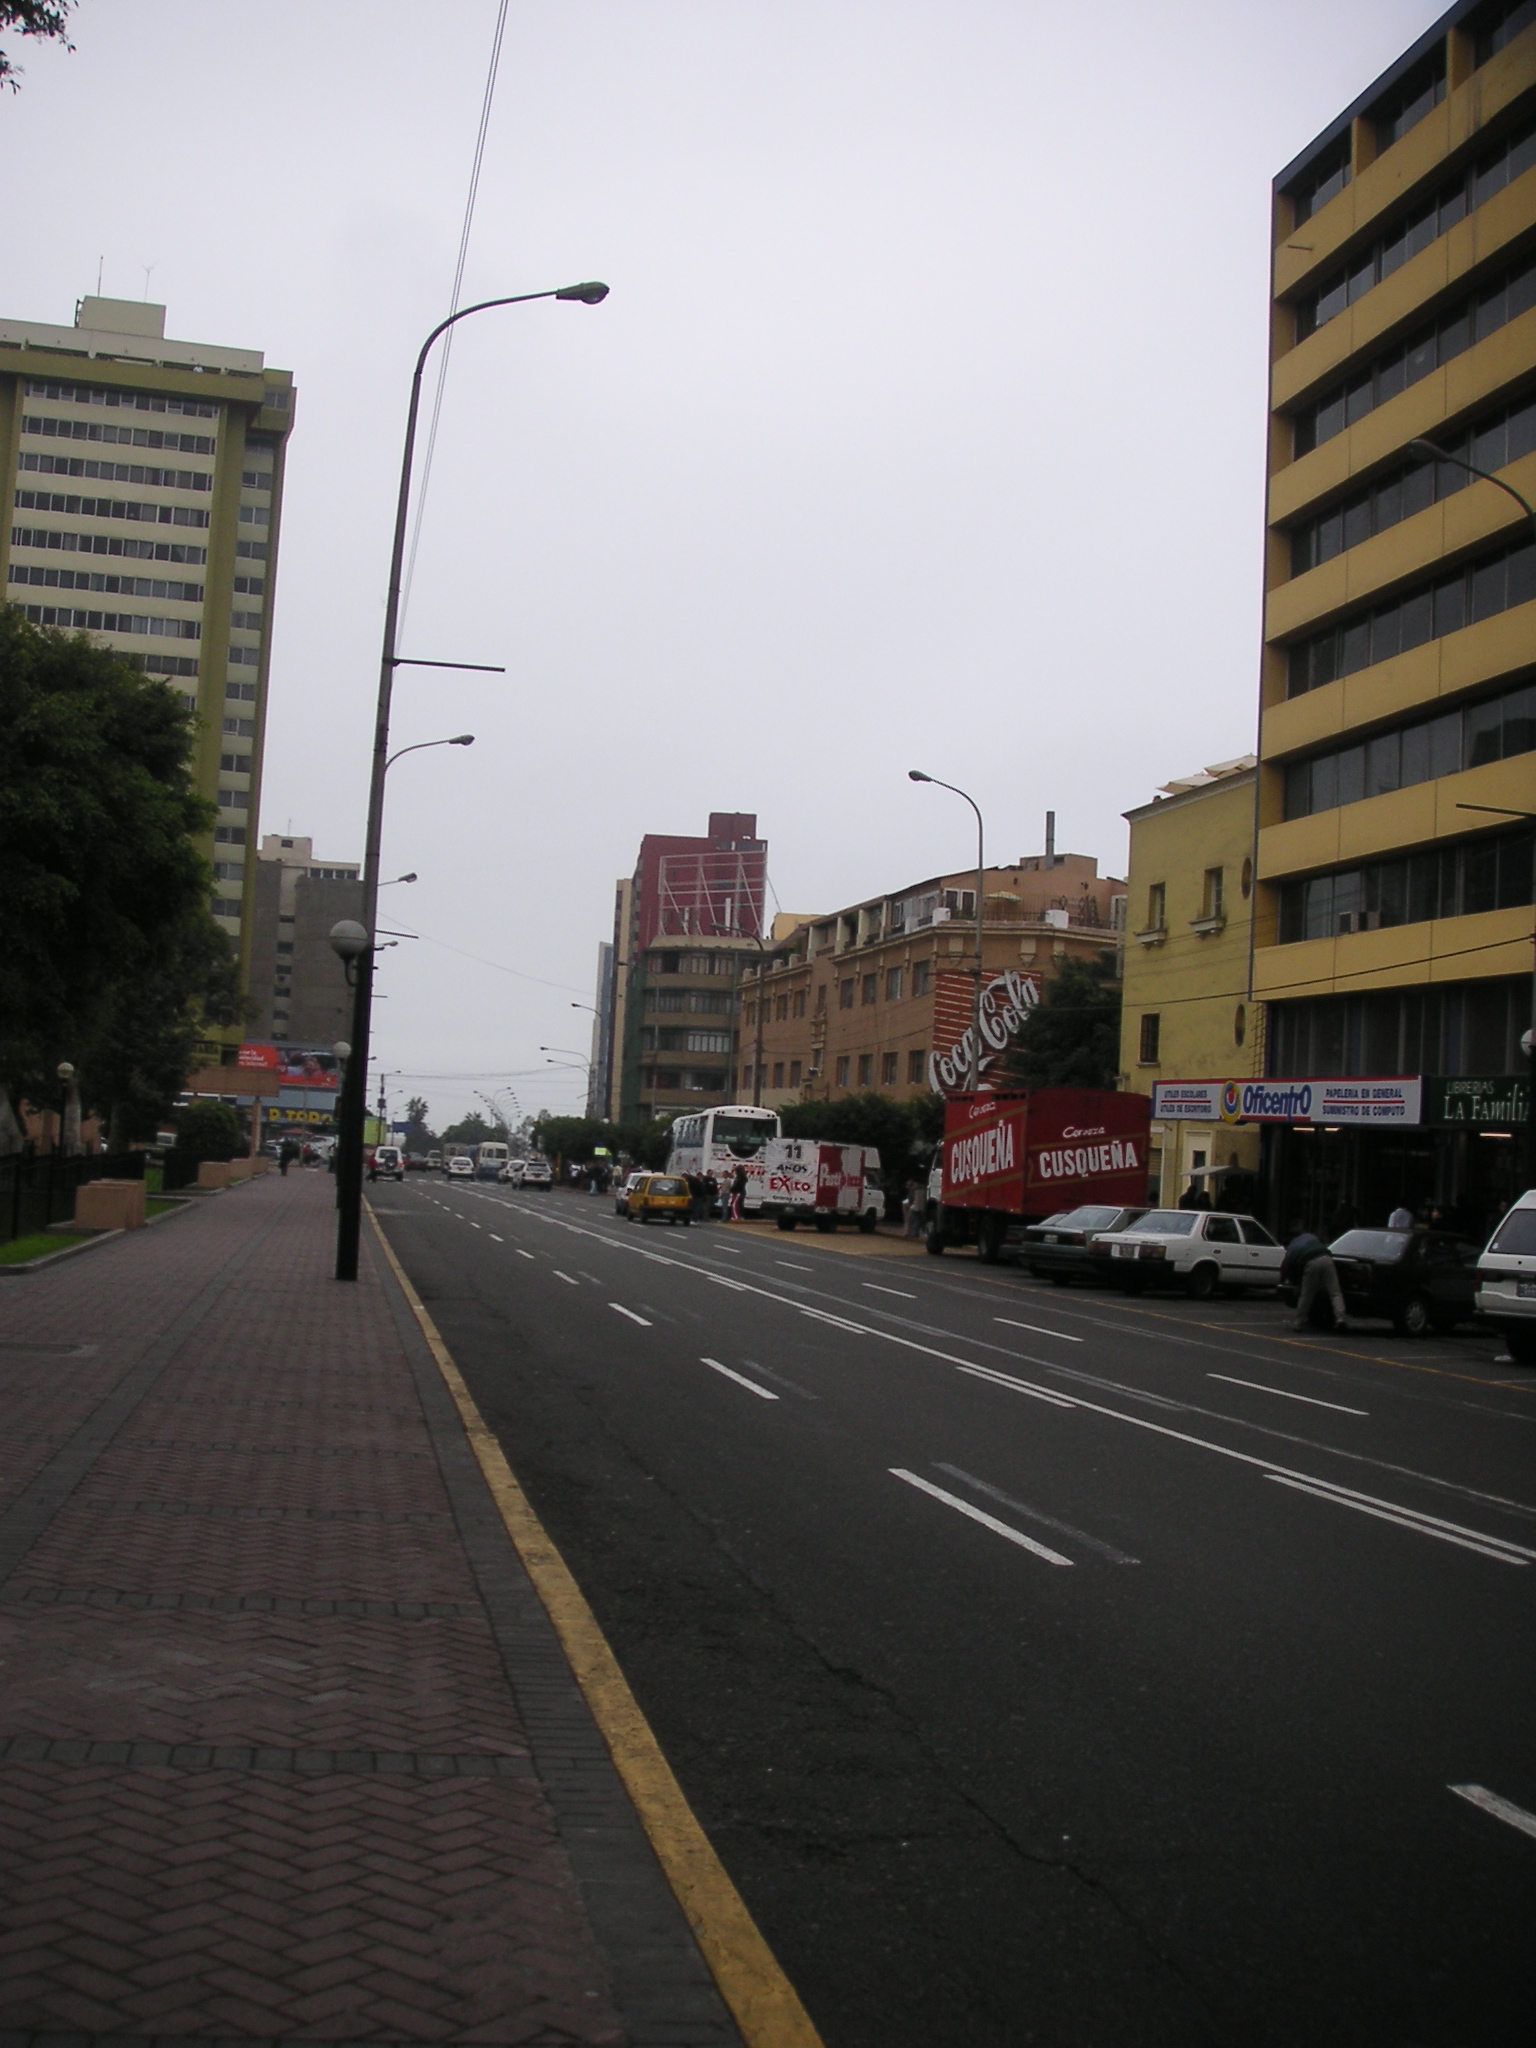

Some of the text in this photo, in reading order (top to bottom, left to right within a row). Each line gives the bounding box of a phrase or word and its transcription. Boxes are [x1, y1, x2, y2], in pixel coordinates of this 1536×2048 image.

[1361, 1089, 1370, 1098] EN
[1373, 1088, 1402, 1098] GENERAL
[1446, 1081, 1495, 1094] LIBRERIAS
[1361, 1106, 1370, 1115] DE
[785, 1144, 802, 1159] 11
[951, 1119, 1014, 1184] CUSQUEÑA
[1039, 1140, 1138, 1178] CUSQUEÑA
